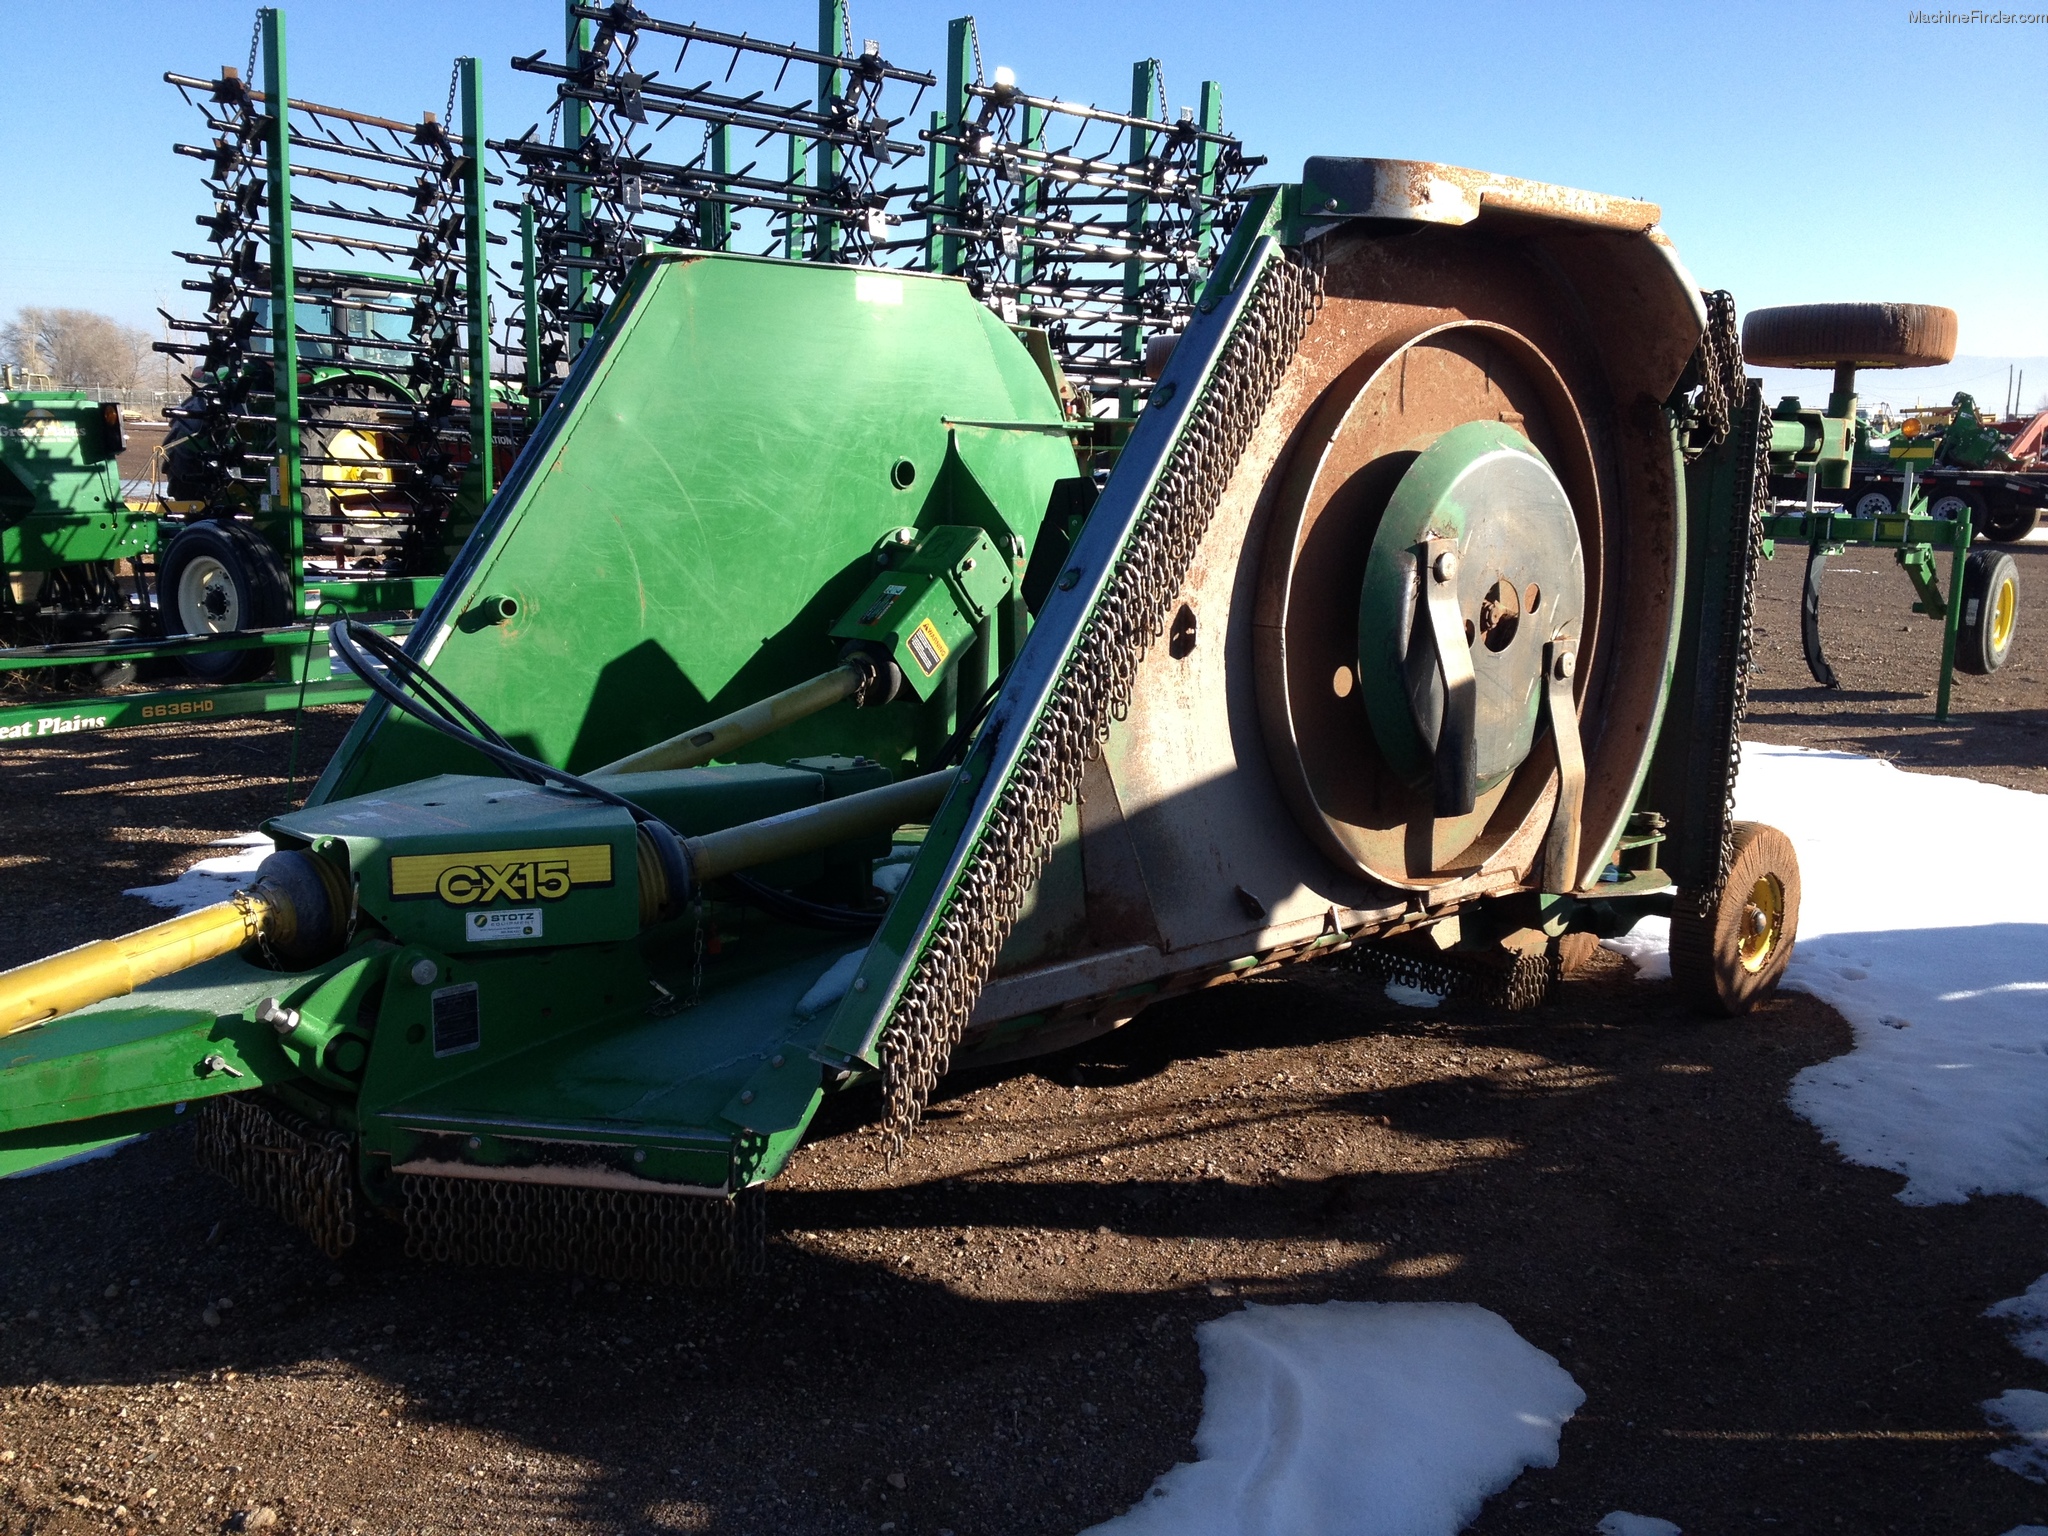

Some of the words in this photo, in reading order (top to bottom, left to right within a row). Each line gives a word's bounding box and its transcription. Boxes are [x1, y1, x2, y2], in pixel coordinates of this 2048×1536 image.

[927, 628, 947, 657] WARNING
[141, 699, 214, 718] 6636HD
[36, 714, 107, 735] Plains
[491, 912, 534, 922] STOTZ
